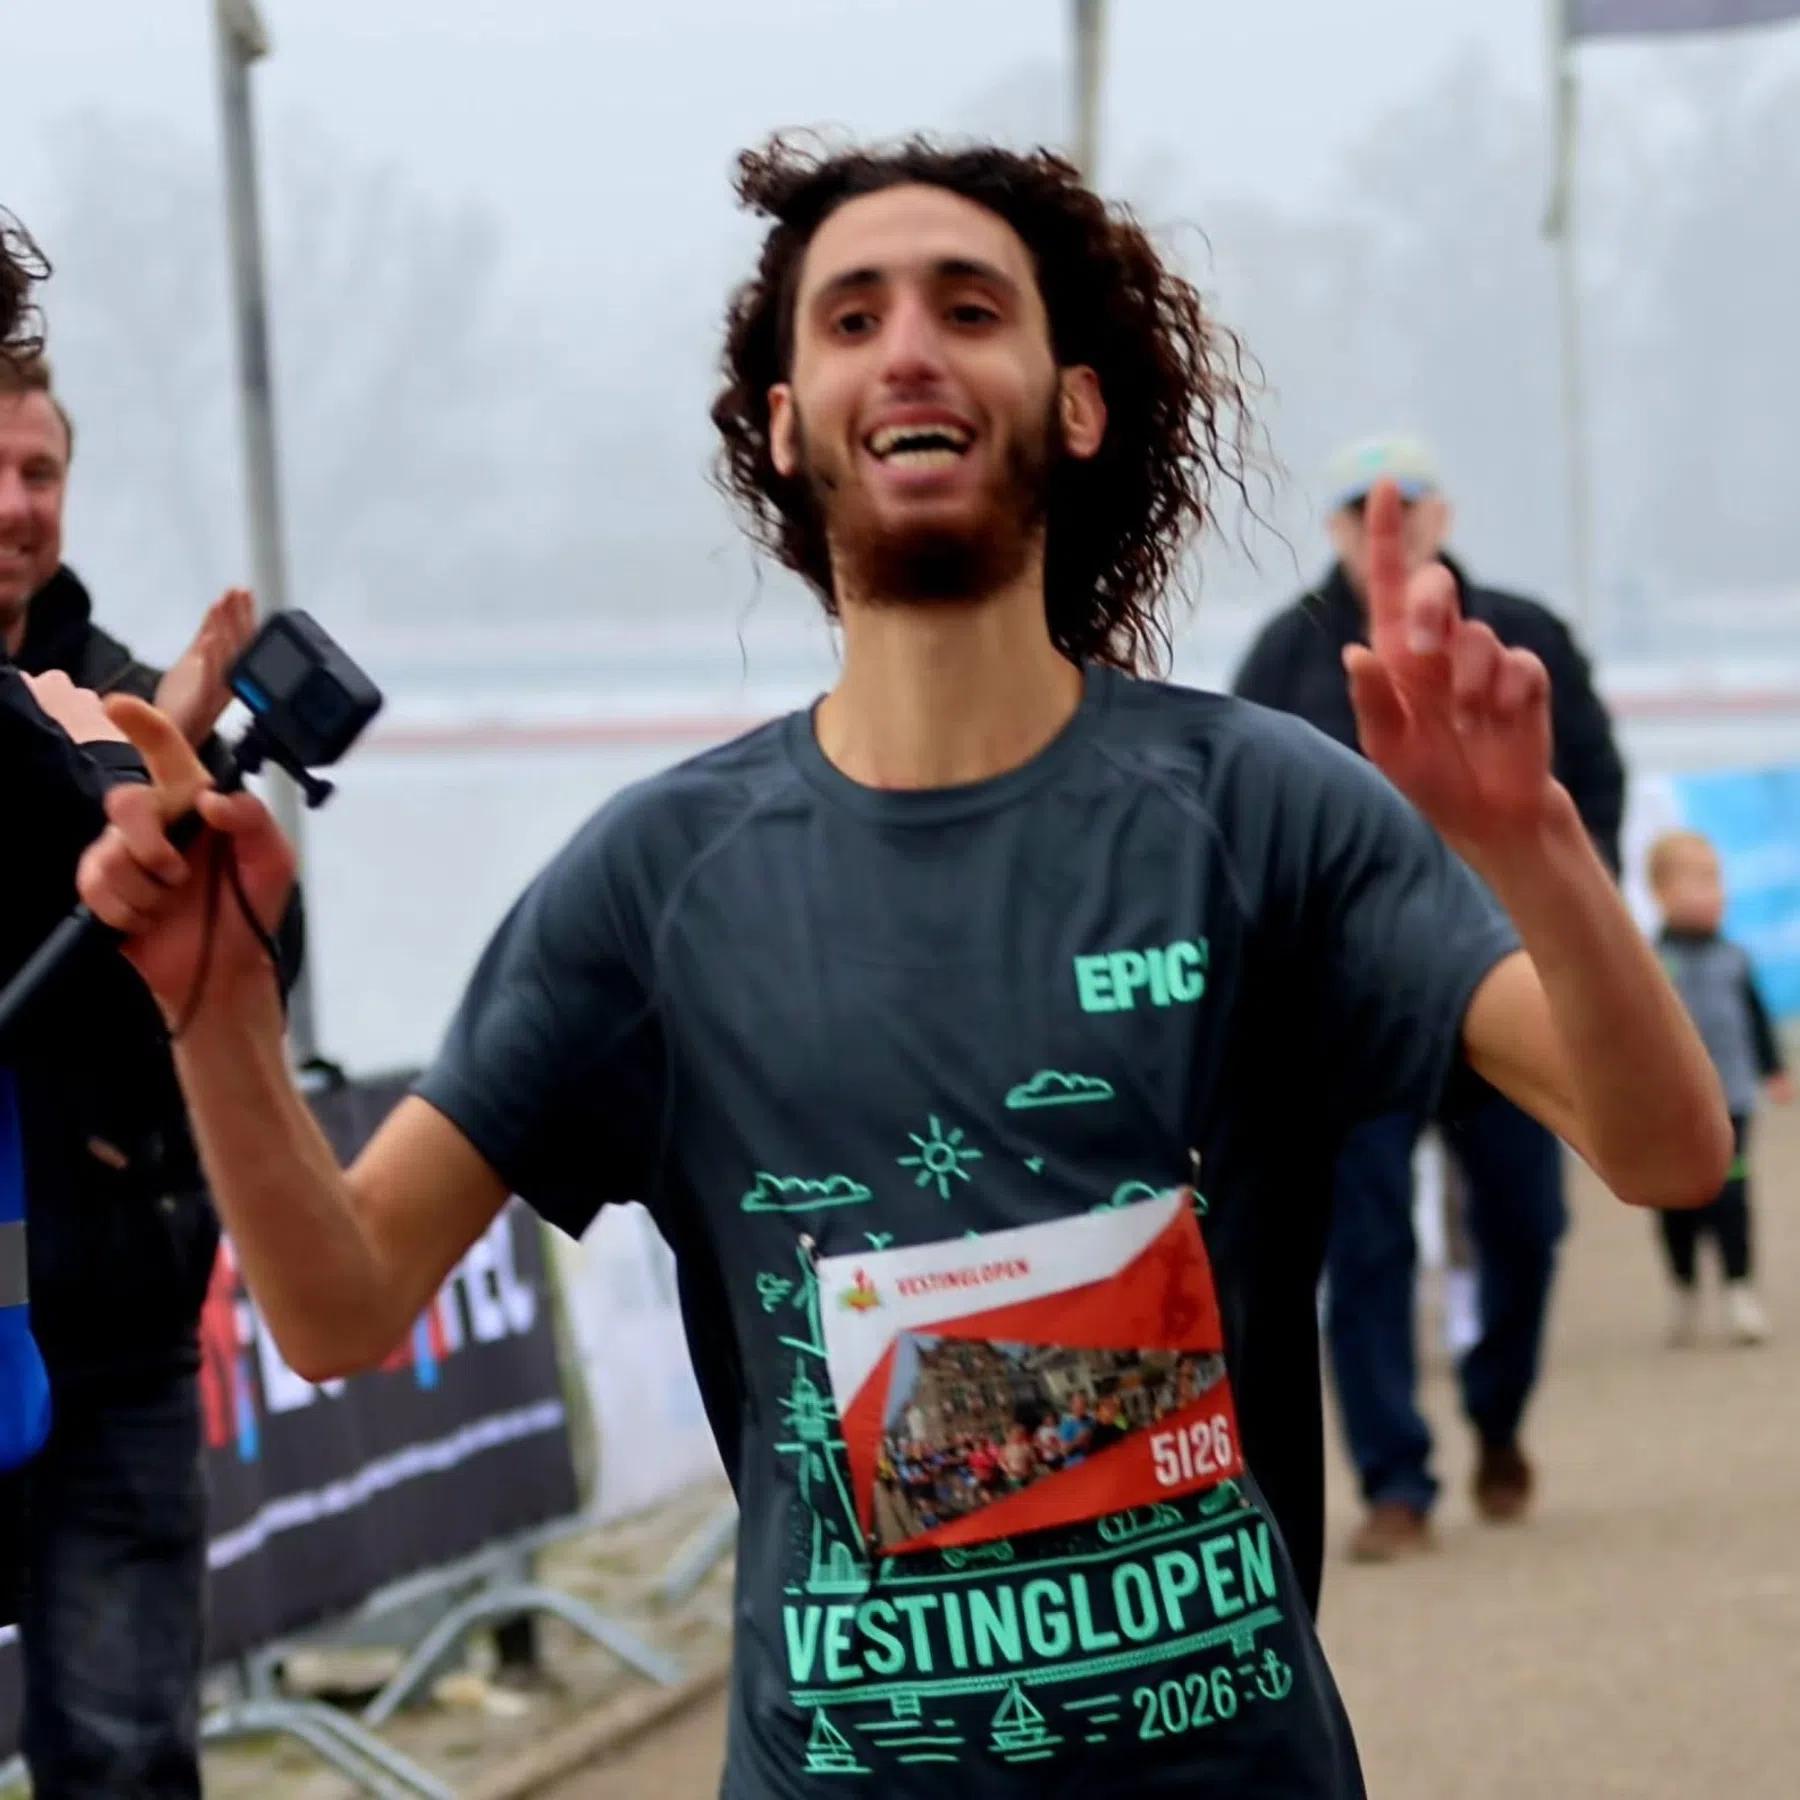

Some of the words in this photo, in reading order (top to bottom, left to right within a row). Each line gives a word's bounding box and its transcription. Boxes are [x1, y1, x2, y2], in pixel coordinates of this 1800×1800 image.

[1149, 1413, 1233, 1488] 5126
[783, 1521, 1278, 1682] VESTINGLOPEN
[1132, 1666, 1238, 1740] 2026
